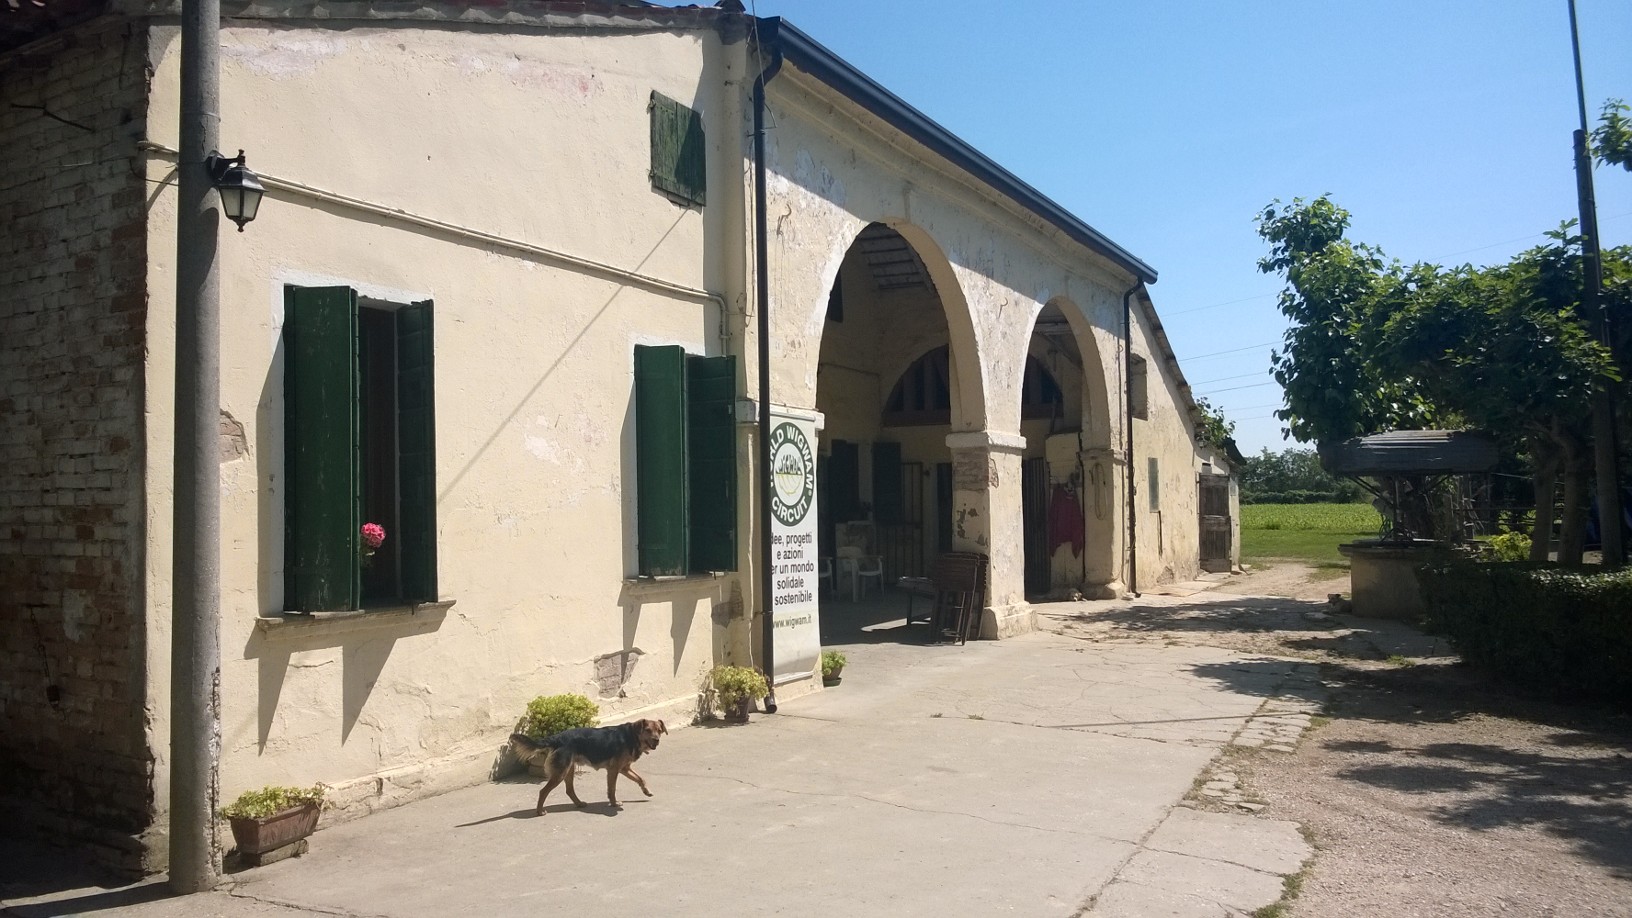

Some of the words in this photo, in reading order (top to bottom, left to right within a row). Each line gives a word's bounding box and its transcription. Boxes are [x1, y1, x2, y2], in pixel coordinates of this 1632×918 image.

[786, 425, 814, 489] WIGWAM
[772, 496, 808, 523] CIRCUIT
[786, 532, 812, 547] progetti
[777, 550, 781, 560] e
[783, 547, 803, 559] azioni
[780, 564, 788, 574] un
[790, 560, 814, 573] mondo
[777, 576, 804, 590] solidale
[774, 590, 812, 606] sostenibile
